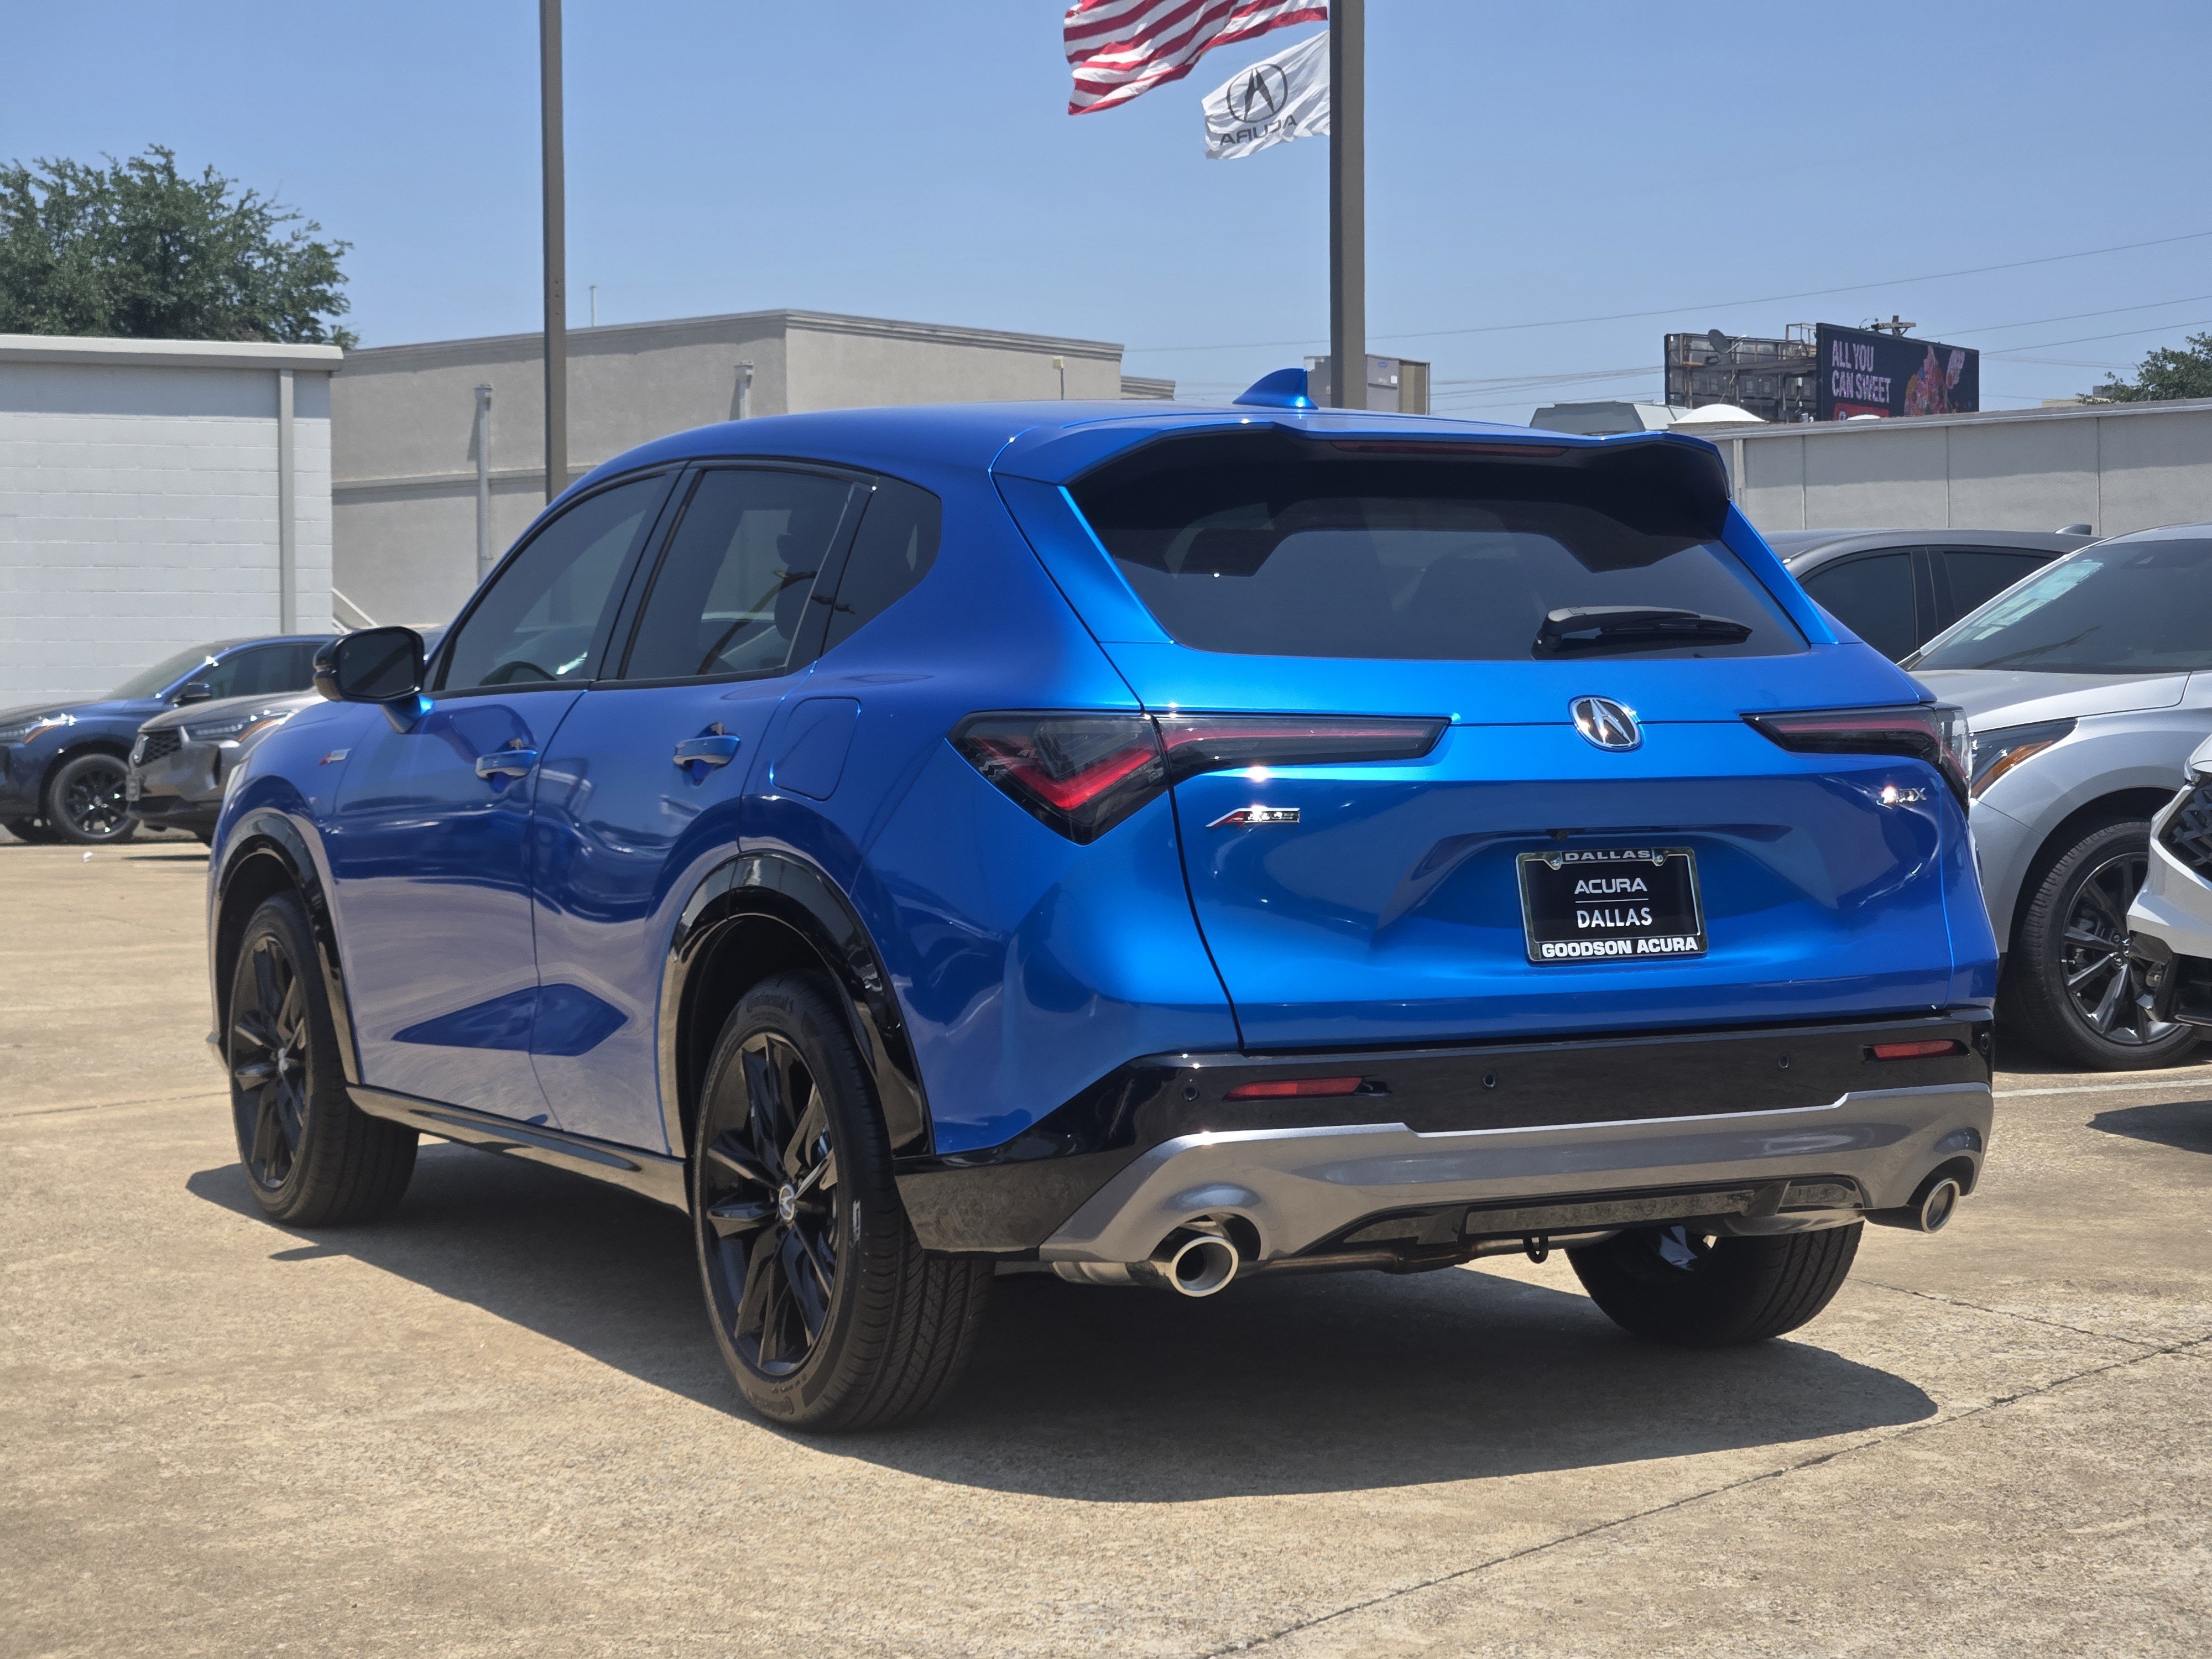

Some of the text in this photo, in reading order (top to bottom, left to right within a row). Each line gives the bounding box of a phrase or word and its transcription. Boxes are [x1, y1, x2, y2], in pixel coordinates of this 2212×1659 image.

[1832, 340, 1874, 372] ALL YOU
[1832, 370, 1891, 404] CAN SWEET
[1565, 850, 1651, 861] DALLAS
[1574, 878, 1648, 894] ACURA
[1577, 907, 1652, 928] DALLAS
[1542, 937, 1698, 958] GOODSON ACURA
